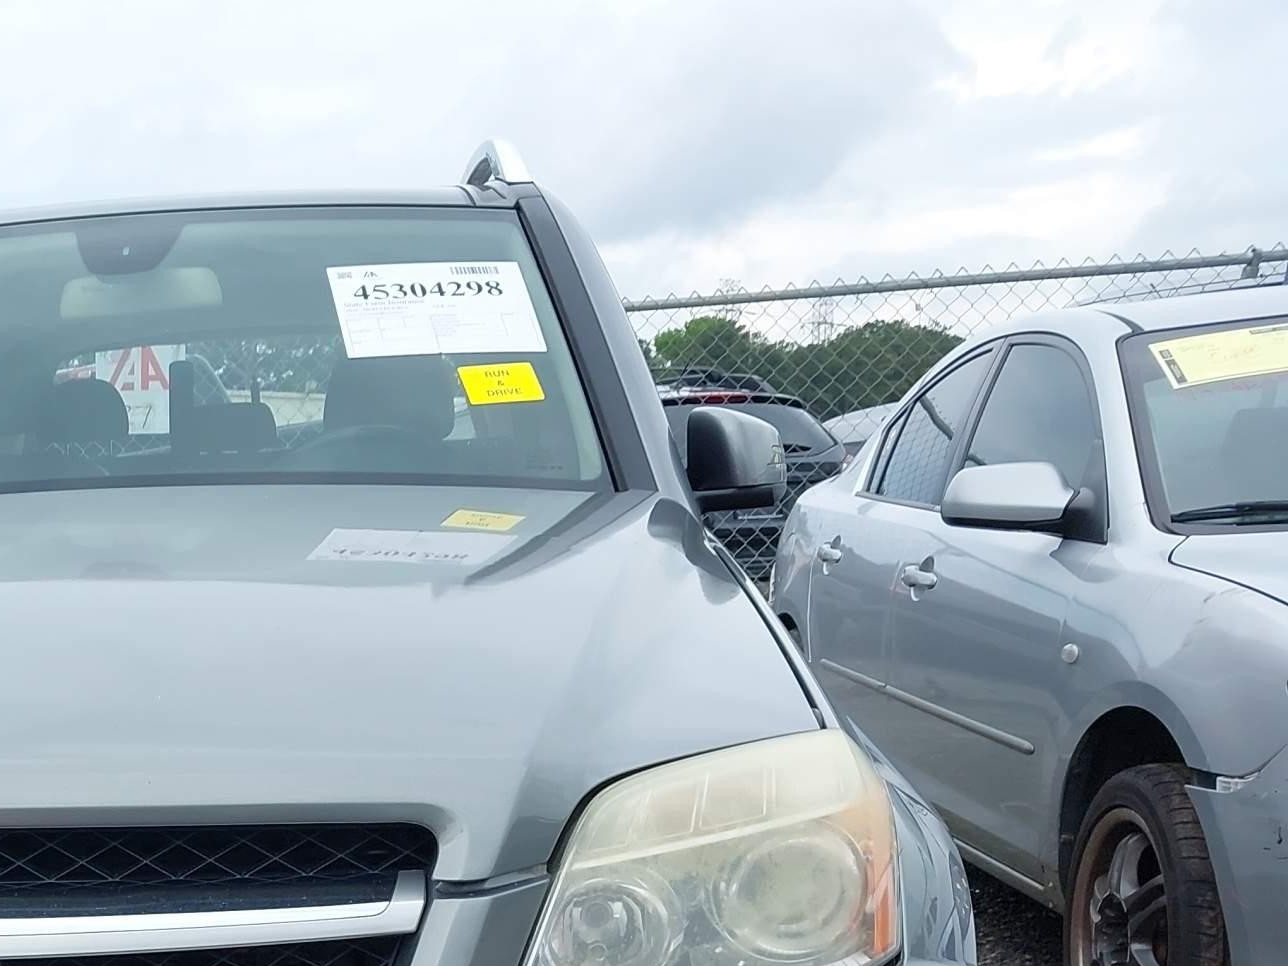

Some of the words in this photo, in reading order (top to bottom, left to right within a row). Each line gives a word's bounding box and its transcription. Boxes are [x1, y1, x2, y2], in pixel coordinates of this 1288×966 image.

[354, 281, 503, 300] 45304298
[484, 369, 510, 378] RUN
[486, 388, 522, 397] DRIVE
